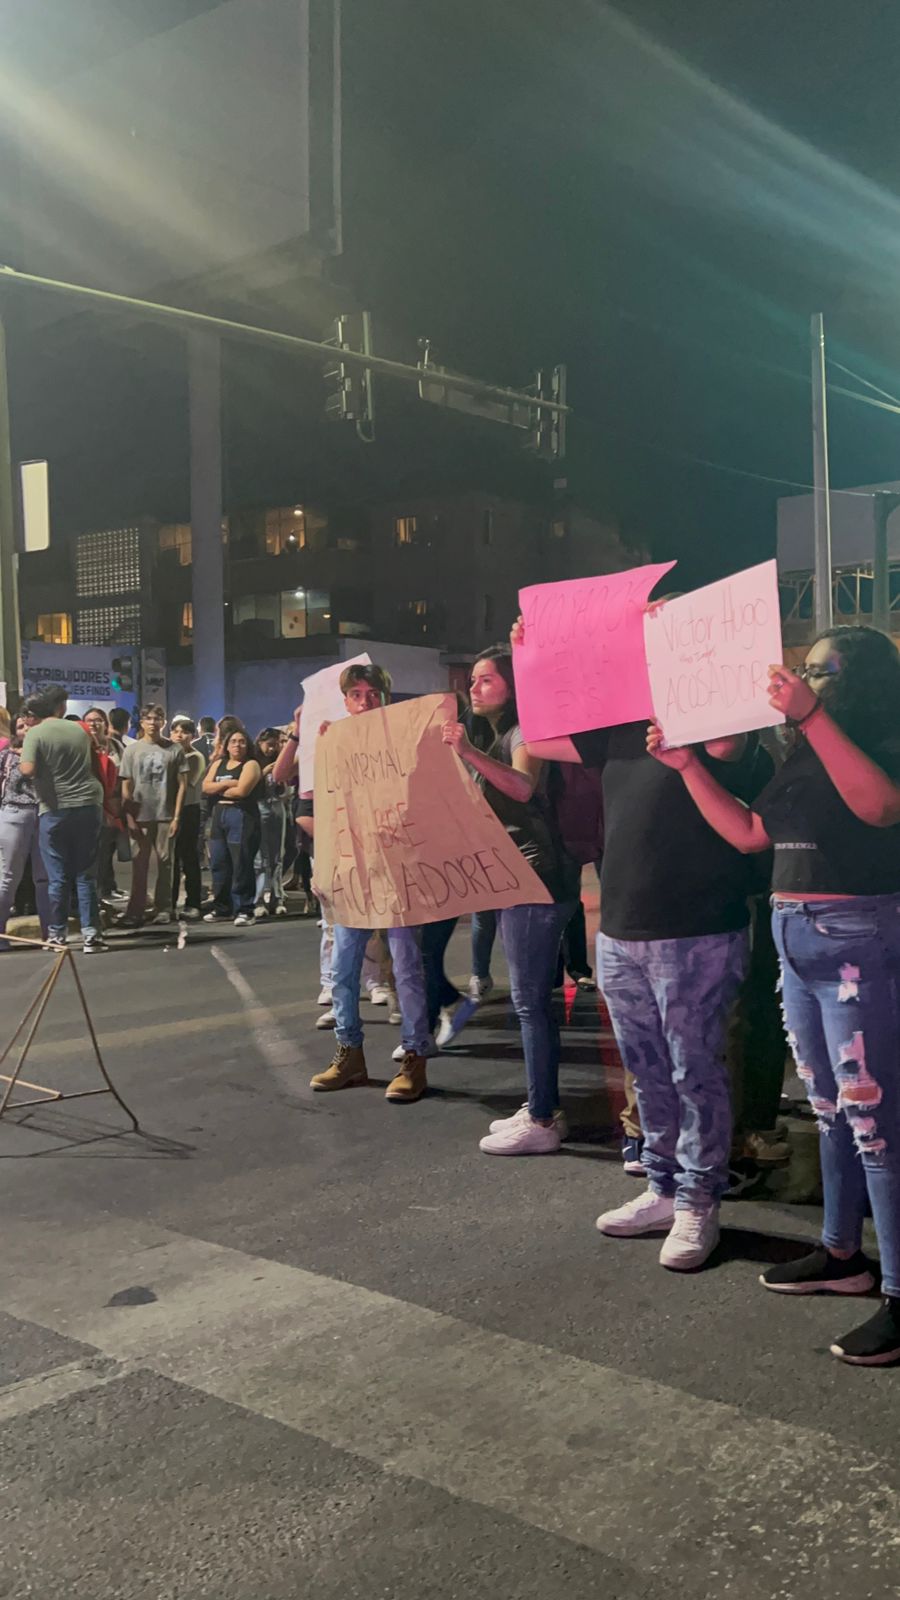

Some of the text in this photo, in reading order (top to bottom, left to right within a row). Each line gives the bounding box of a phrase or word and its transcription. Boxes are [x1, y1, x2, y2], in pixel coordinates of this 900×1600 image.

[721, 584, 768, 650] Hugo
[666, 660, 765, 720] ACOSADOR
[331, 847, 520, 916] ACOSADORES
